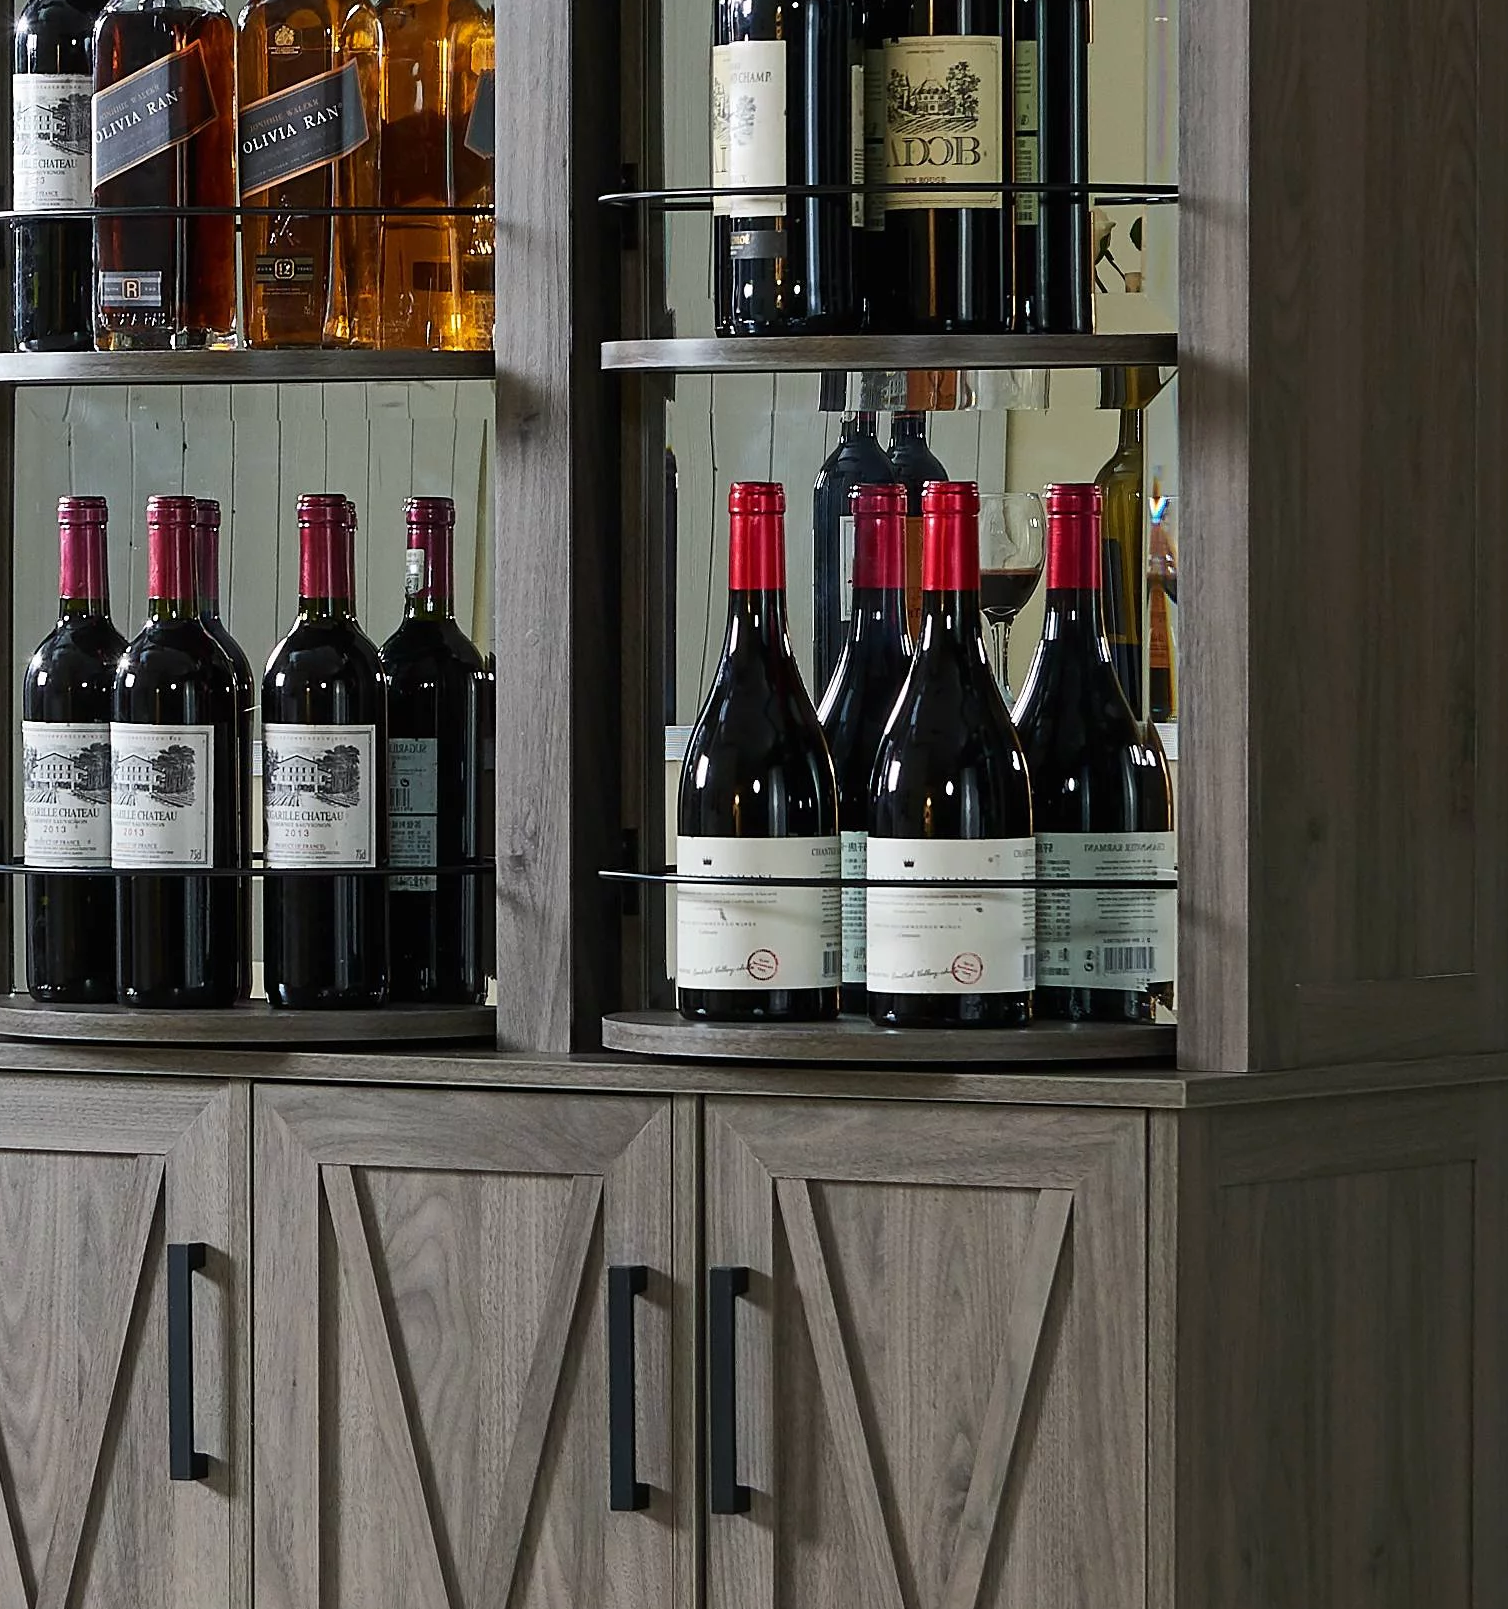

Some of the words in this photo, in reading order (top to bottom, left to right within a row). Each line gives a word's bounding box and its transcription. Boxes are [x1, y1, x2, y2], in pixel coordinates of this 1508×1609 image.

[95, 111, 142, 144] OLIVIA
[146, 90, 179, 115] RAN
[242, 123, 298, 154] OLIVIA
[303, 104, 339, 130] RAN
[38, 158, 78, 169] CHATEAU
[126, 281, 138, 298] R
[58, 807, 101, 818] CHATEAU
[137, 810, 178, 821] CHATEAU
[301, 810, 344, 822] CHATEAU
[43, 824, 67, 834] 2013
[123, 827, 144, 837] 2013
[285, 828, 310, 838] 2013
